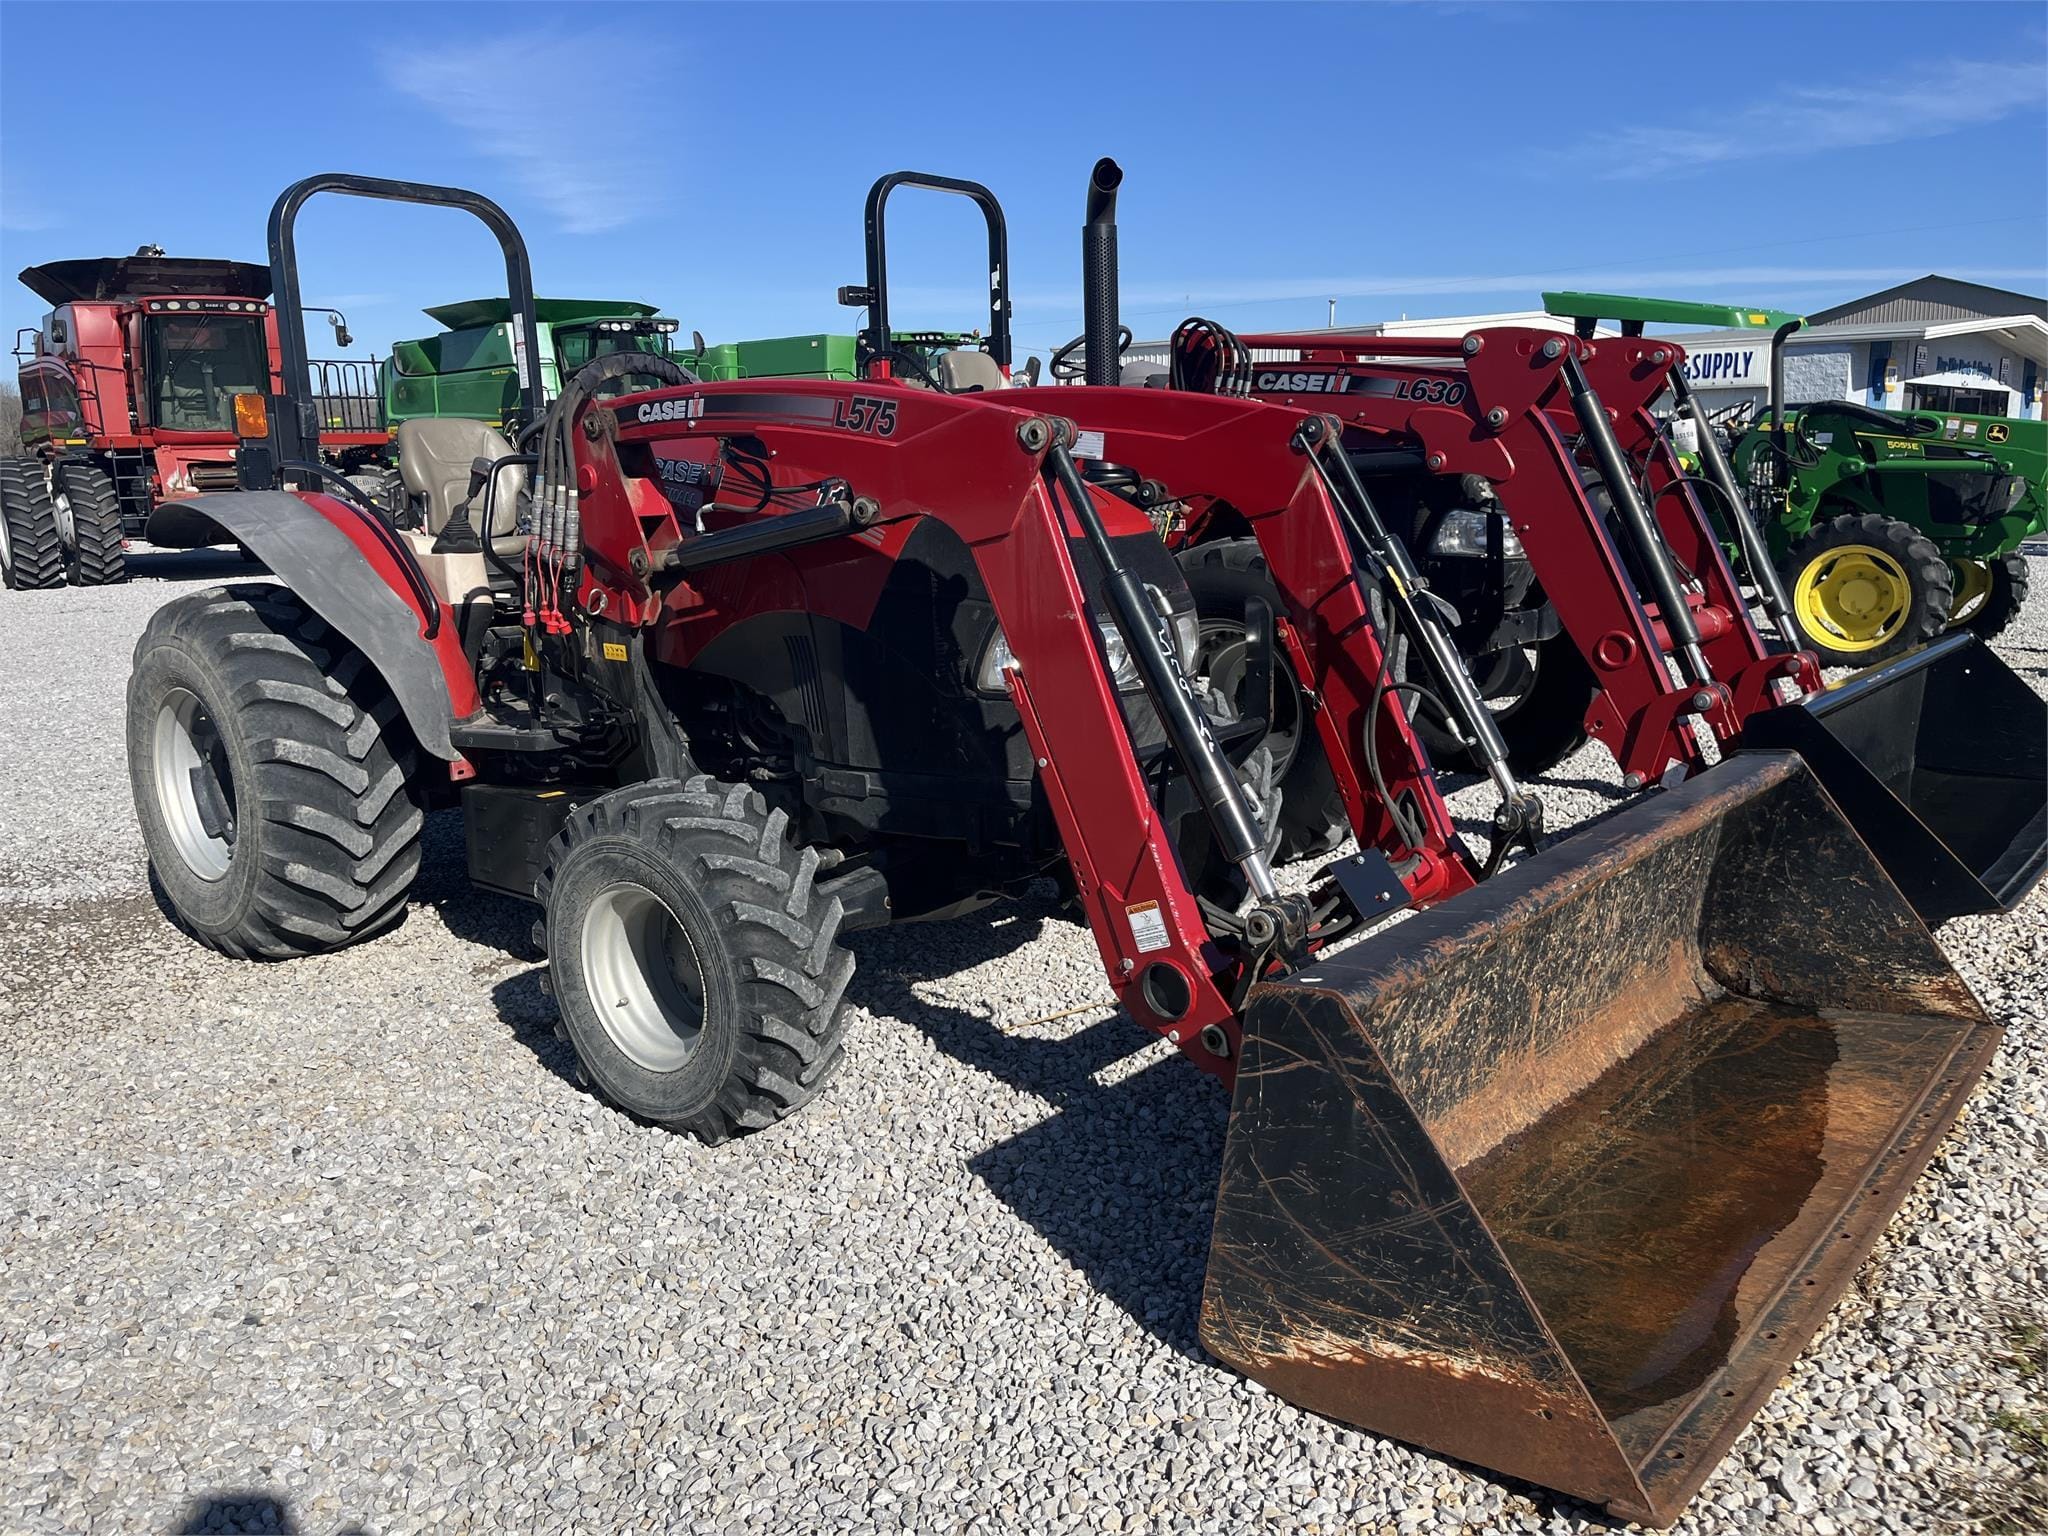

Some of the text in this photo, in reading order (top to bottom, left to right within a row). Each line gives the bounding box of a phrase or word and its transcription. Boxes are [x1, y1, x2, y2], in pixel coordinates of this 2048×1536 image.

[1692, 351, 1754, 380] SUPPLY
[1257, 373, 1327, 393] CASE
[1396, 377, 1467, 407] L630
[638, 399, 687, 423] CASE
[834, 395, 898, 437] L575
